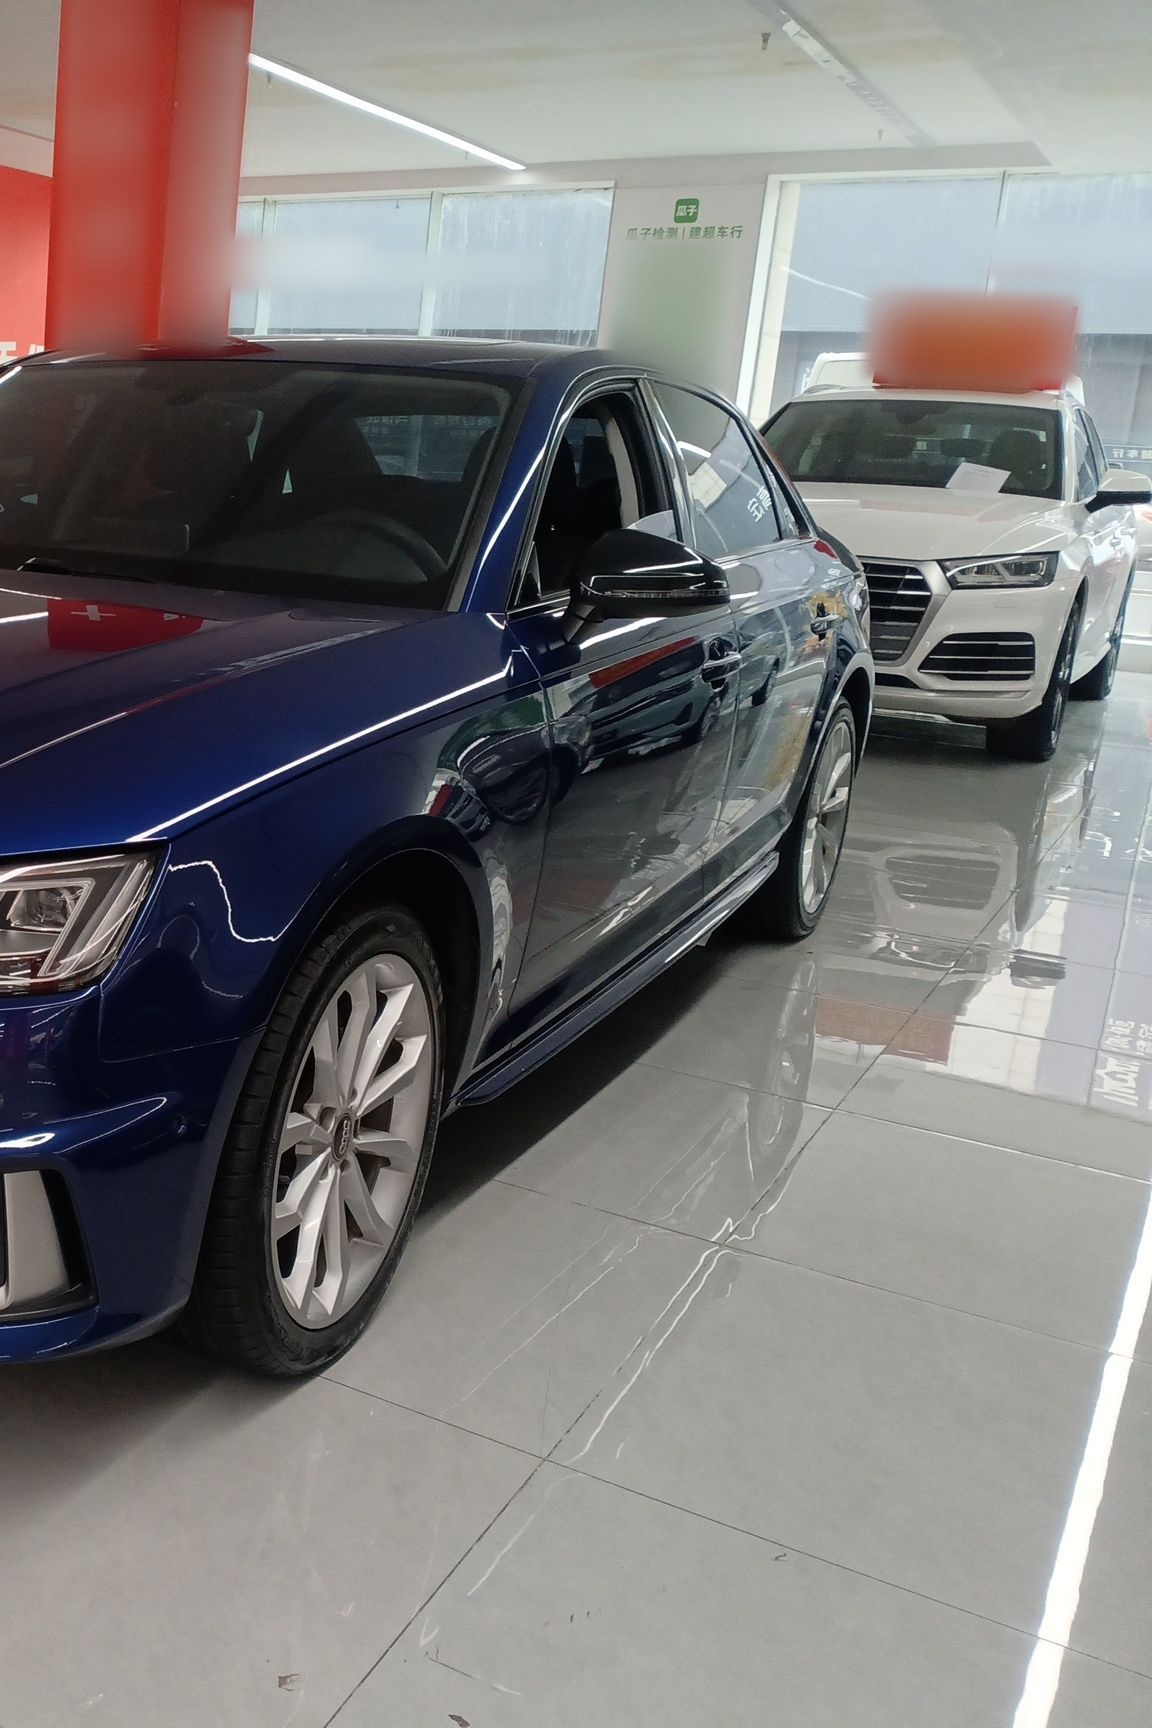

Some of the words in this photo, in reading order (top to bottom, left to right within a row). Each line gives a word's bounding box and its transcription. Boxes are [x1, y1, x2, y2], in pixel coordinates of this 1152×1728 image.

[676, 205, 698, 217] 瓜子
[626, 227, 679, 241] 瓜子检测
